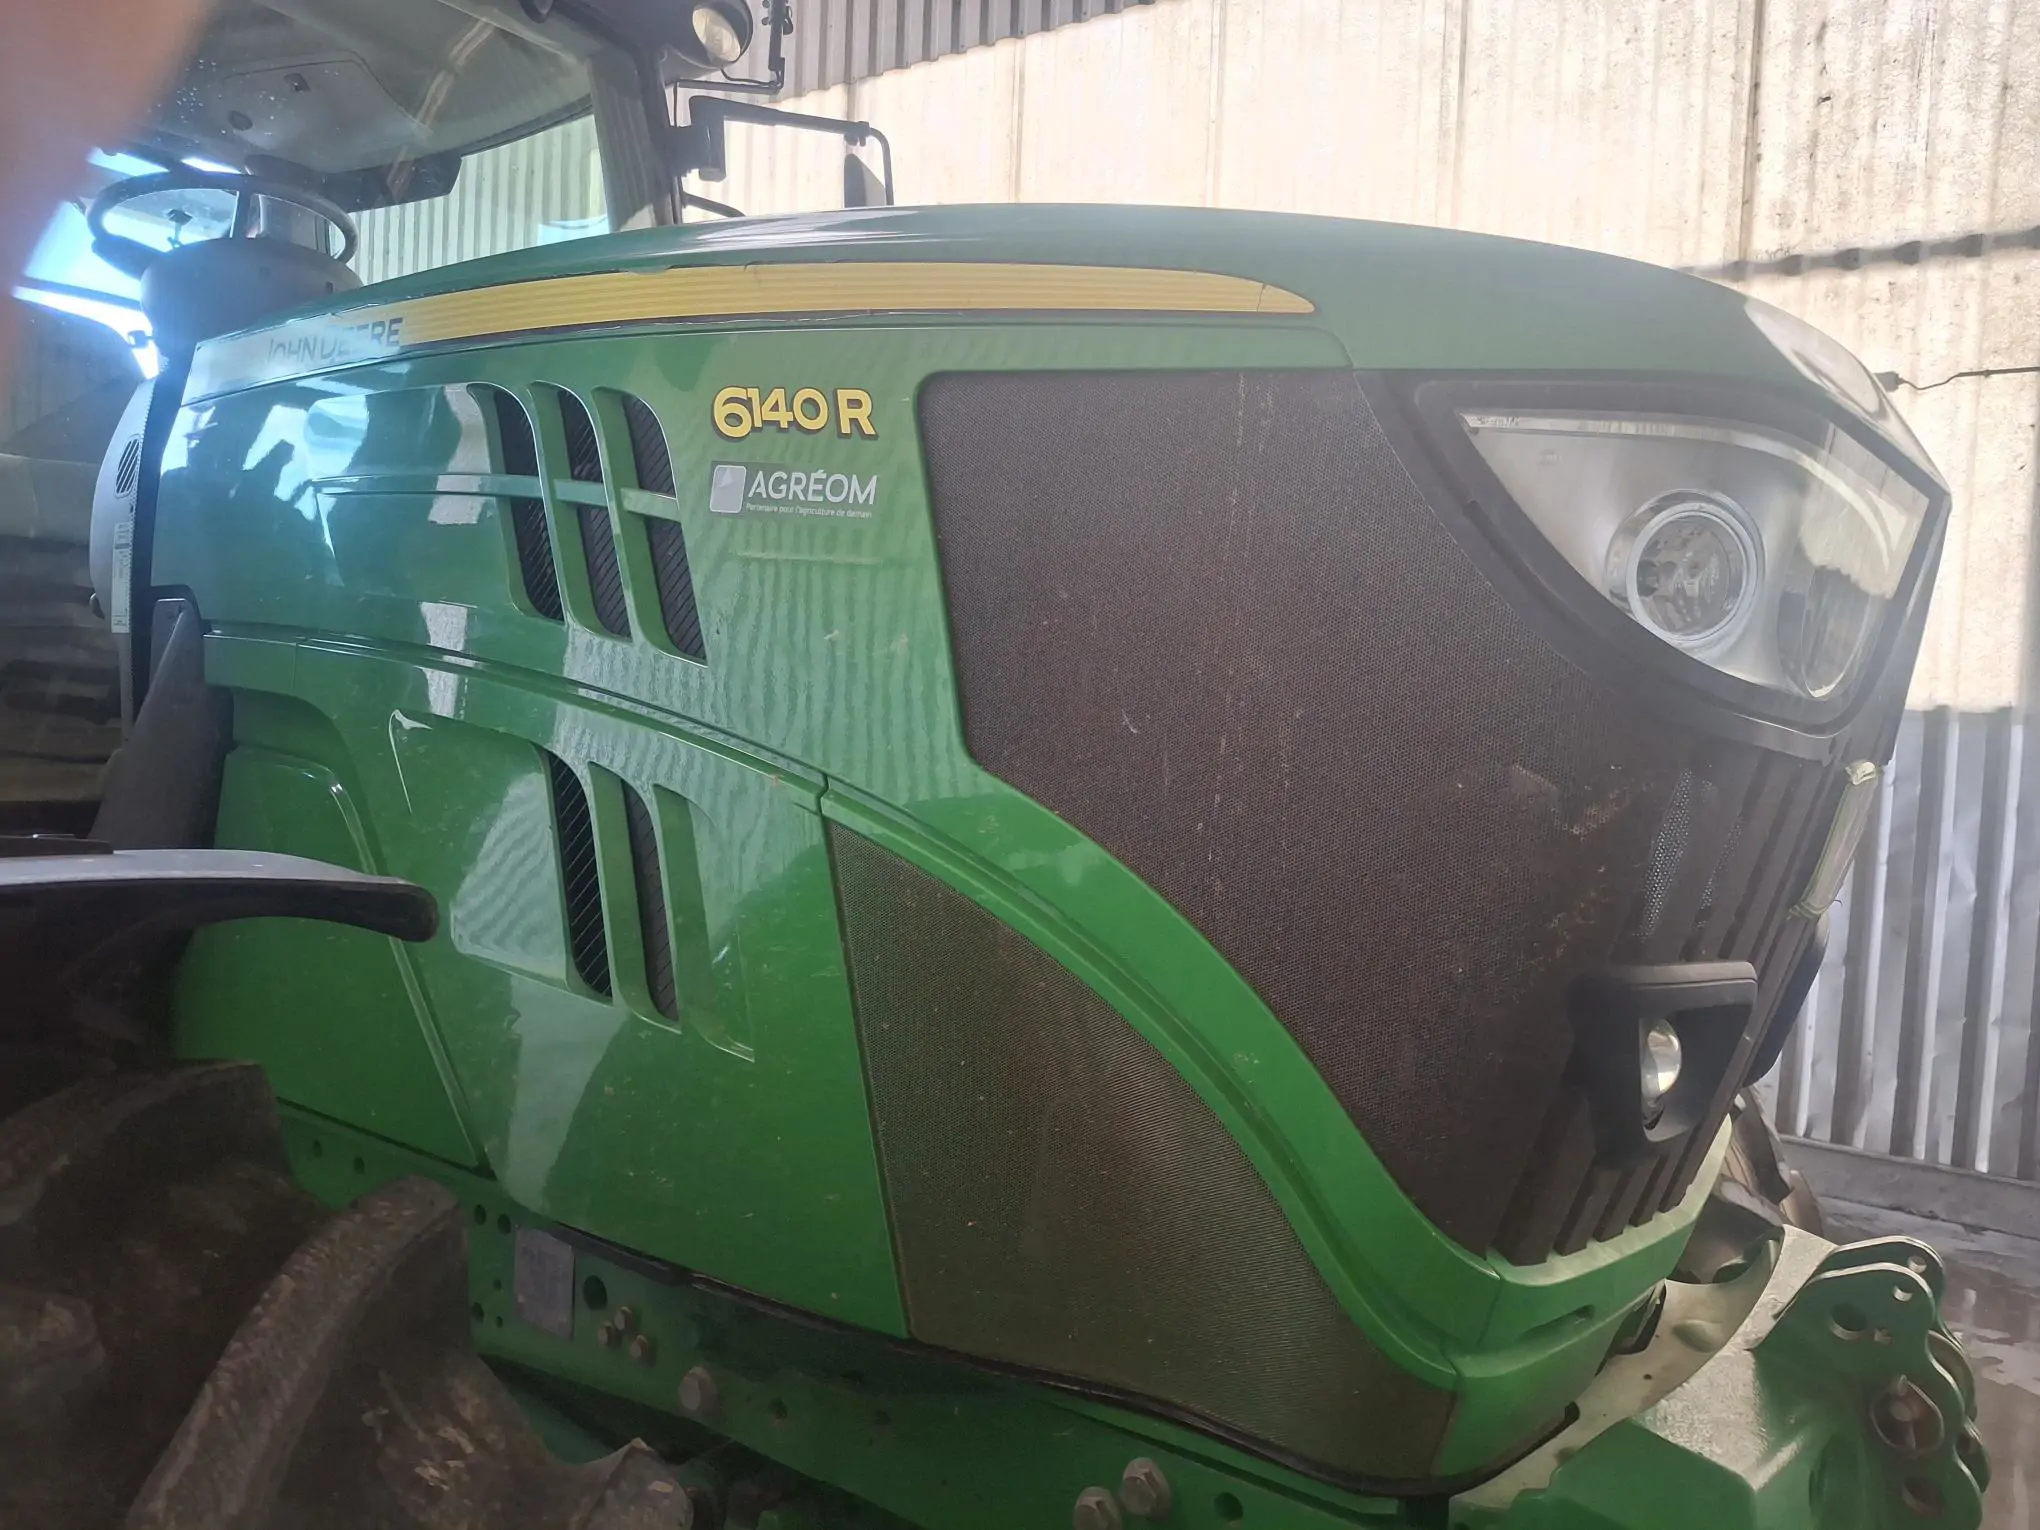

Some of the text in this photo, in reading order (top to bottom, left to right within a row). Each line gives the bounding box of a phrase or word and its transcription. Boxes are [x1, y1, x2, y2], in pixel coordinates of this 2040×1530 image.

[713, 386, 829, 439] 6140
[748, 469, 878, 505] AGRÉOM
[779, 505, 794, 514] pour
[836, 508, 846, 516] de
[846, 509, 872, 519] demain
